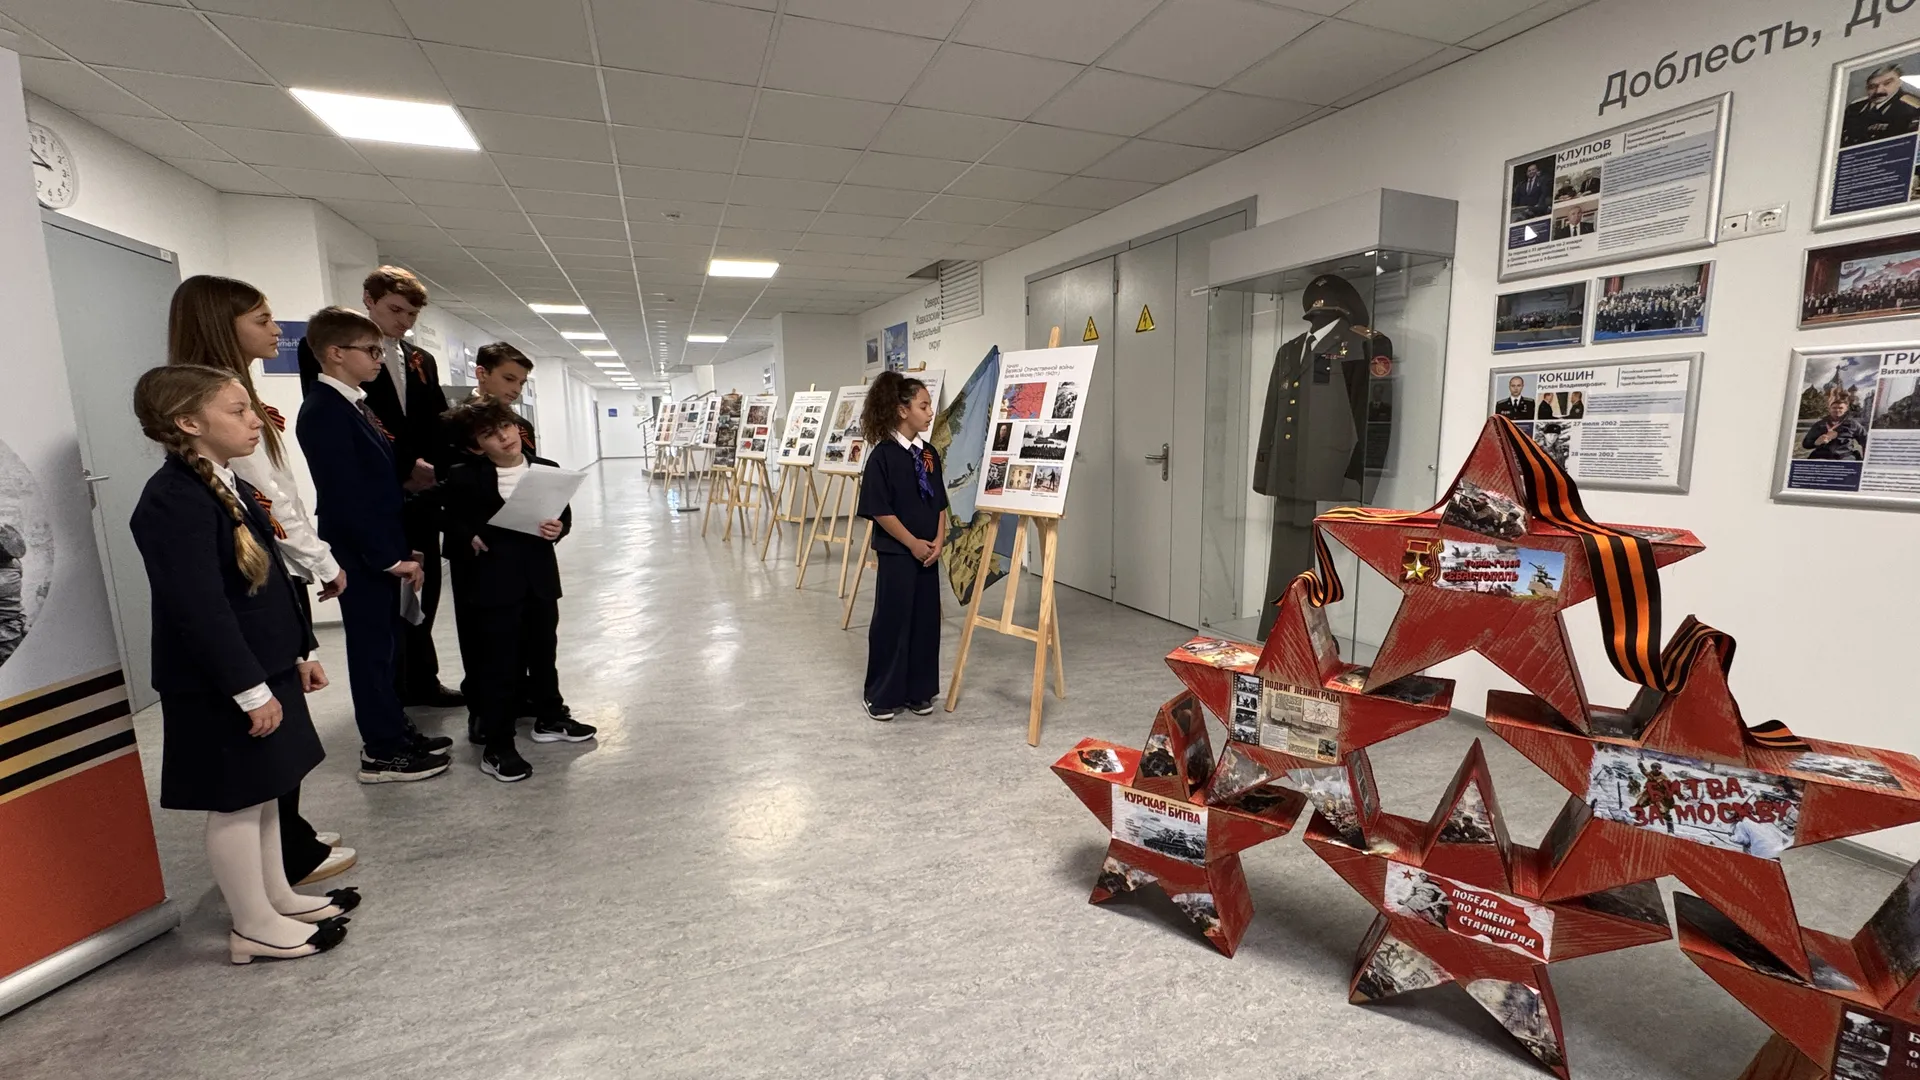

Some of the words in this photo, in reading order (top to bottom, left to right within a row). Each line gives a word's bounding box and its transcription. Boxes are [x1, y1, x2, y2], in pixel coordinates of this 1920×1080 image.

[1598, 20, 1822, 116] Доблесть,
[1557, 139, 1612, 163] КЛУПОВ
[1538, 370, 1594, 383] КОКШИН
[1442, 571, 1519, 582] СЕВАСТОПОЛЬ
[1264, 679, 1292, 693] ПОДВИГ
[1294, 686, 1341, 704] ЛЕНИНГРАДА
[1124, 791, 1167, 811] КУРСКАЯ
[1645, 777, 1746, 803] БИТВА
[1168, 806, 1201, 825] БИТВА
[1629, 804, 1665, 827] ЗА
[1673, 800, 1792, 825] МОСКВУ
[1452, 889, 1498, 910] ПОБЕДА
[1456, 902, 1472, 913] ПО
[1474, 908, 1516, 927] ИМЕНИ
[1459, 915, 1536, 949] СТАЛИНГРАД
